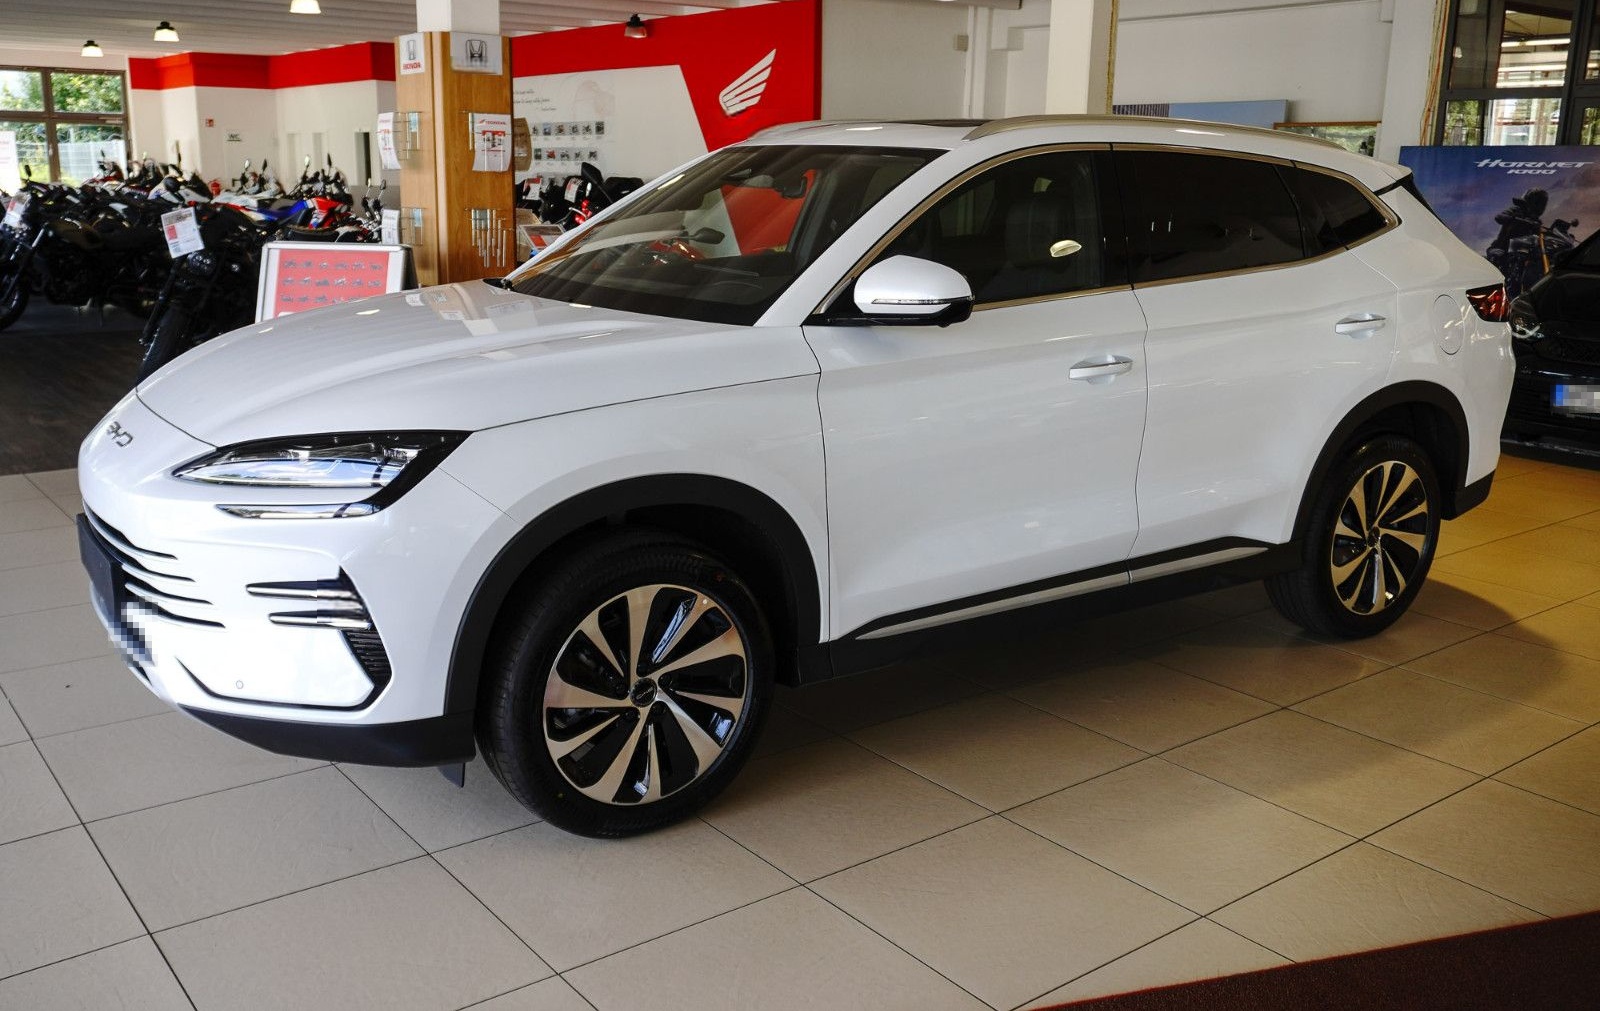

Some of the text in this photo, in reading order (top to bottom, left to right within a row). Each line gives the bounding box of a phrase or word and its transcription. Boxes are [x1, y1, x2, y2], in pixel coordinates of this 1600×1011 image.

[403, 62, 421, 70] HONDA
[1474, 158, 1594, 168] HORNET
[106, 421, 133, 447] BYD
